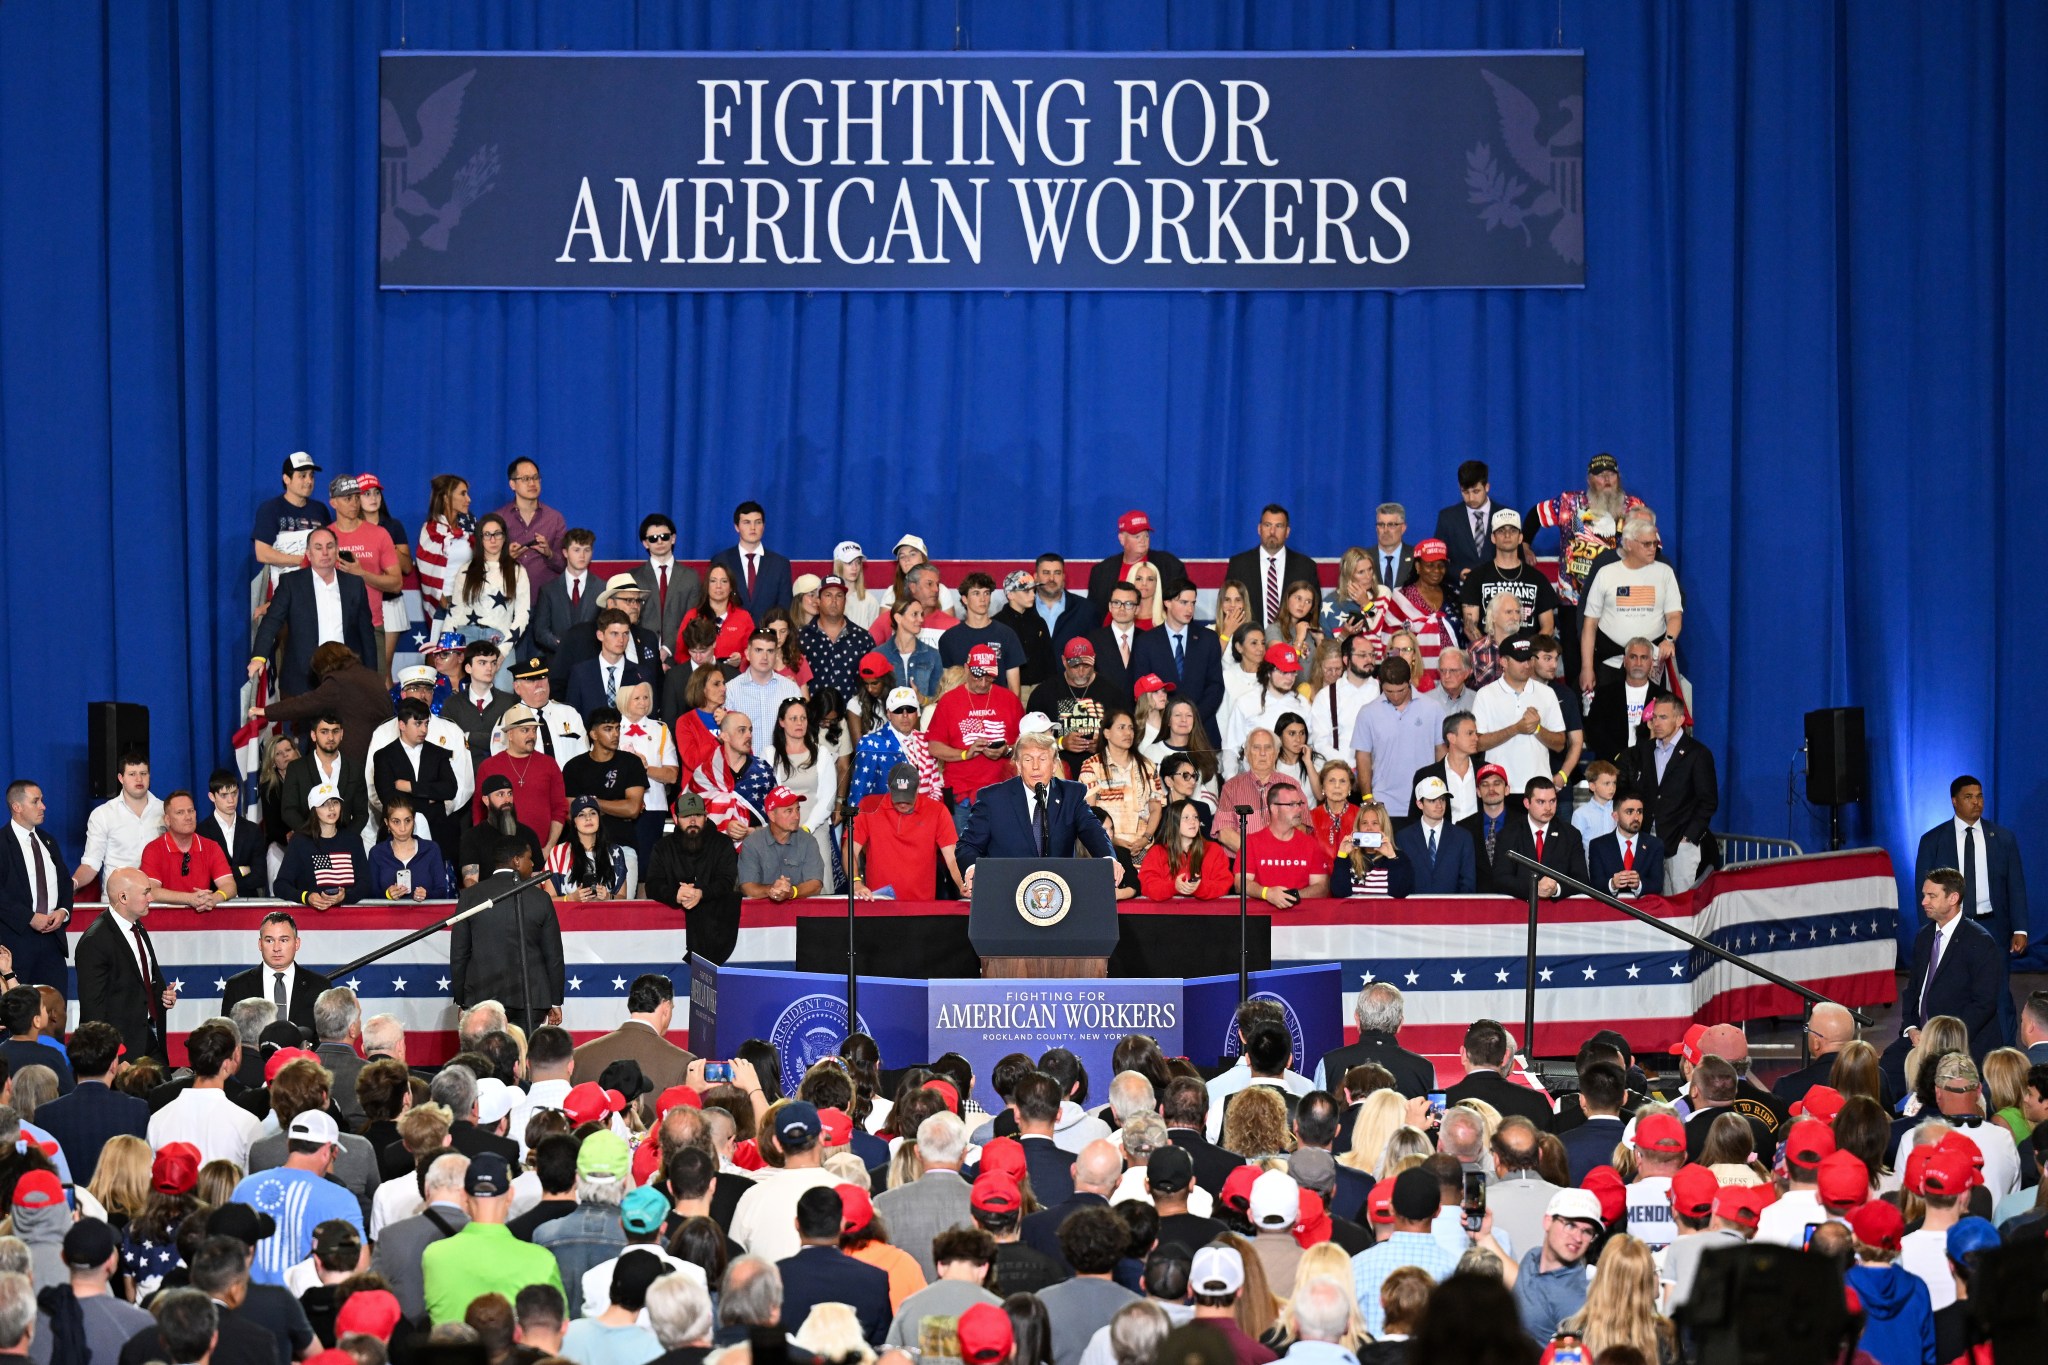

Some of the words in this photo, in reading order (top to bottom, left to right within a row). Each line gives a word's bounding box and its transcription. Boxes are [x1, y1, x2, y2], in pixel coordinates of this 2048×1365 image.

[697, 79, 1090, 166] FIGHTING
[1114, 80, 1278, 166] FOR
[556, 177, 989, 264] AMERICAN
[1008, 177, 1409, 264] WORKERS
[973, 653, 995, 661] TRUMP
[895, 690, 909, 699] 47
[1070, 718, 1101, 728] SPEAK
[605, 769, 618, 780] 45
[604, 779, 616, 788] 47
[319, 785, 333, 794] 47
[1006, 992, 1075, 1001] FIGHTING
[1079, 992, 1105, 1001] FOR
[936, 1004, 1056, 1028] AMERICAN
[1062, 1004, 1175, 1028] WORKERS
[772, 998, 821, 1050] PRESIDENT
[824, 1000, 834, 1008] OF
[836, 1003, 848, 1017] THE
[983, 1033, 1033, 1041] ROCKLAND
[1036, 1033, 1076, 1041] COUNTY,
[1284, 1009, 1302, 1061] UNITED
[1740, 1103, 1751, 1112] TO
[1753, 1105, 1775, 1126] RIDE
[1925, 1169, 1949, 1180] TRUMP
